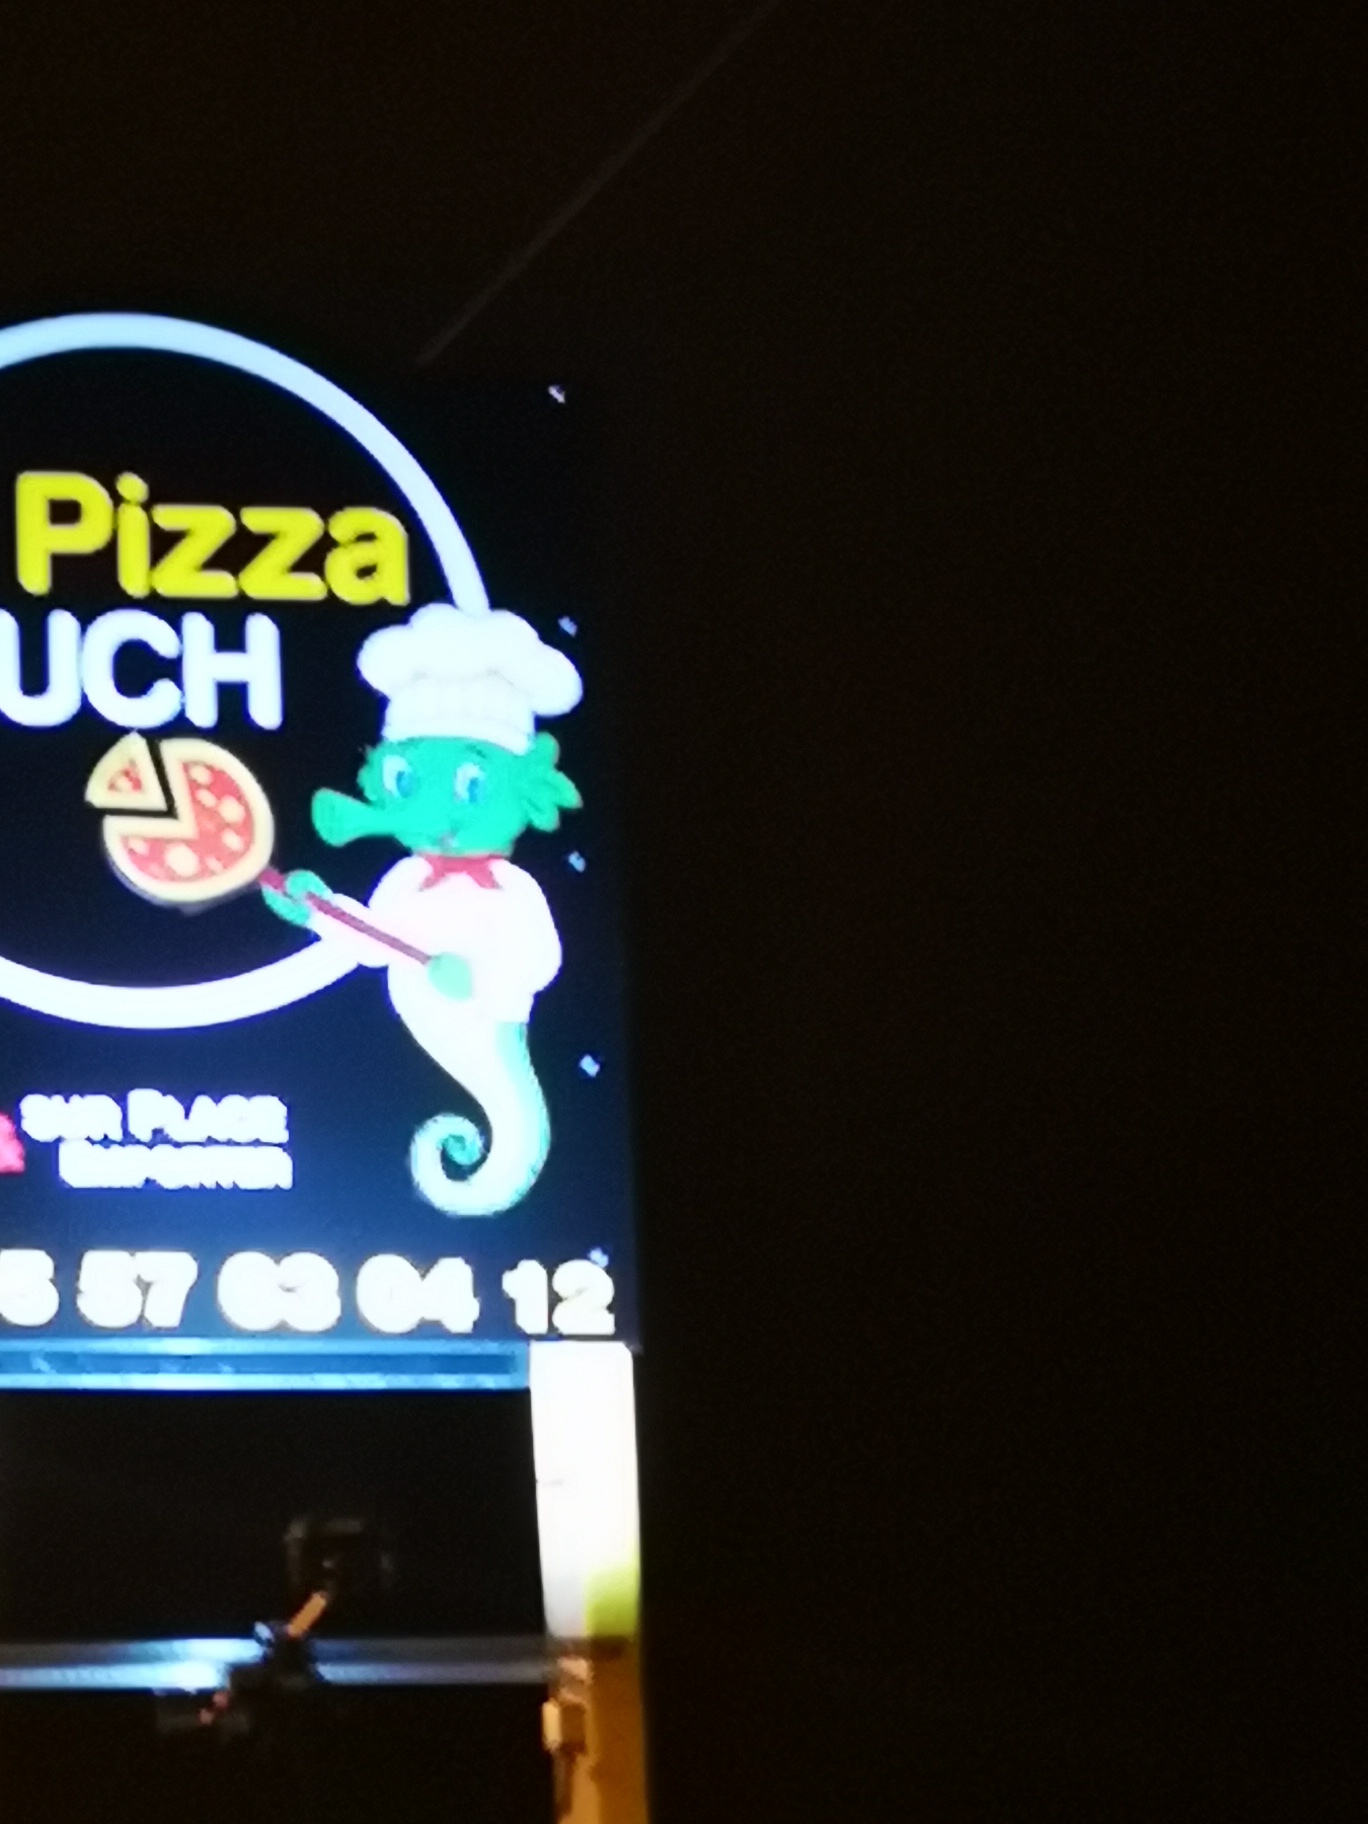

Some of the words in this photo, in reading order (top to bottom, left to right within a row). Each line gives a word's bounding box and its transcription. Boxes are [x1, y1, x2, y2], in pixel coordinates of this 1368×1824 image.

[15, 471, 409, 603] Pizza
[76, 1249, 198, 1331] 57
[355, 1253, 480, 1334] 04
[502, 1256, 615, 1335] 12
